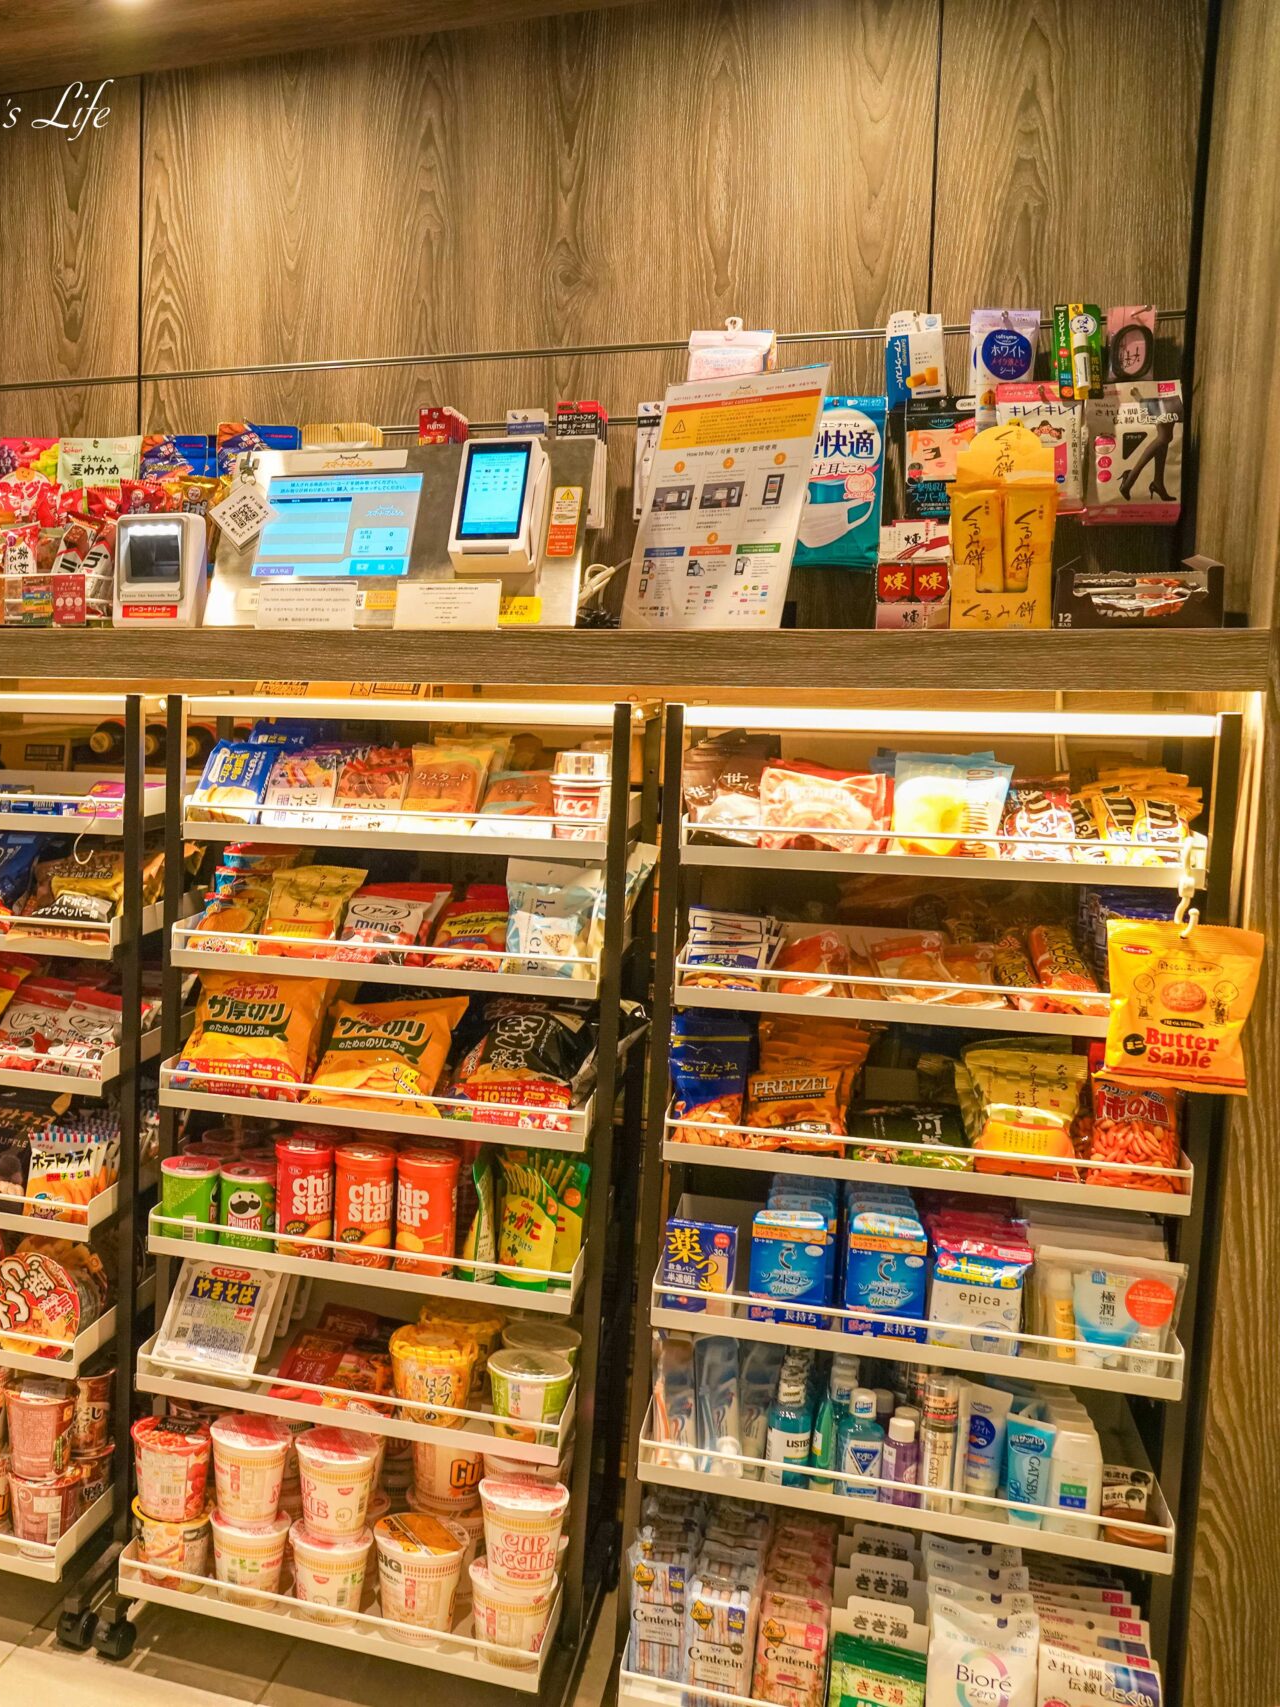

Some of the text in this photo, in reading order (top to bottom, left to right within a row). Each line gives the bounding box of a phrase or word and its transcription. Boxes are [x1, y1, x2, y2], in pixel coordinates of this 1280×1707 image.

[991, 345, 1025, 358] ホワイト
[999, 367, 1016, 375] シート
[1009, 404, 1077, 417] キレイキレイ
[427, 422, 446, 430] FUJITSU
[704, 449, 714, 457] buy
[70, 464, 121, 477] 茎わかめ
[961, 600, 1037, 623] くるみ餅
[1058, 613, 1072, 623] 12
[417, 771, 470, 781] カスタード
[456, 926, 486, 935] mini
[223, 982, 279, 1000] ポテトチップス
[207, 995, 286, 1023] ザ厚切り
[1145, 1027, 1220, 1052] Butter
[1147, 1047, 1212, 1069] Sablé
[753, 1076, 837, 1097] PRETZEL
[1095, 1090, 1170, 1123] 柿の種
[31, 1147, 94, 1170] ポテトフライ
[397, 1180, 430, 1208] hip
[227, 1216, 261, 1230] PRINGLES
[214, 1267, 248, 1280] ペヤング
[195, 1278, 257, 1306] やきそば
[771, 1283, 799, 1295] Moist
[958, 1288, 1002, 1308] epica
[869, 1295, 899, 1307] Moist
[1098, 1289, 1117, 1317] 極潤
[784, 1309, 818, 1325] 長持ち
[882, 1322, 918, 1337] 長持ち
[1027, 1455, 1041, 1501] GATSBY
[502, 1533, 550, 1554] CUP
[489, 1545, 556, 1573] NOODLE
[855, 1573, 910, 1599] きき湯
[852, 1614, 910, 1640] きき湯
[956, 1662, 1012, 1694] Bioré
[856, 1679, 904, 1706] きき湯
[968, 1687, 997, 1701] Zero
[1068, 1678, 1154, 1707] 伝線しにくい
